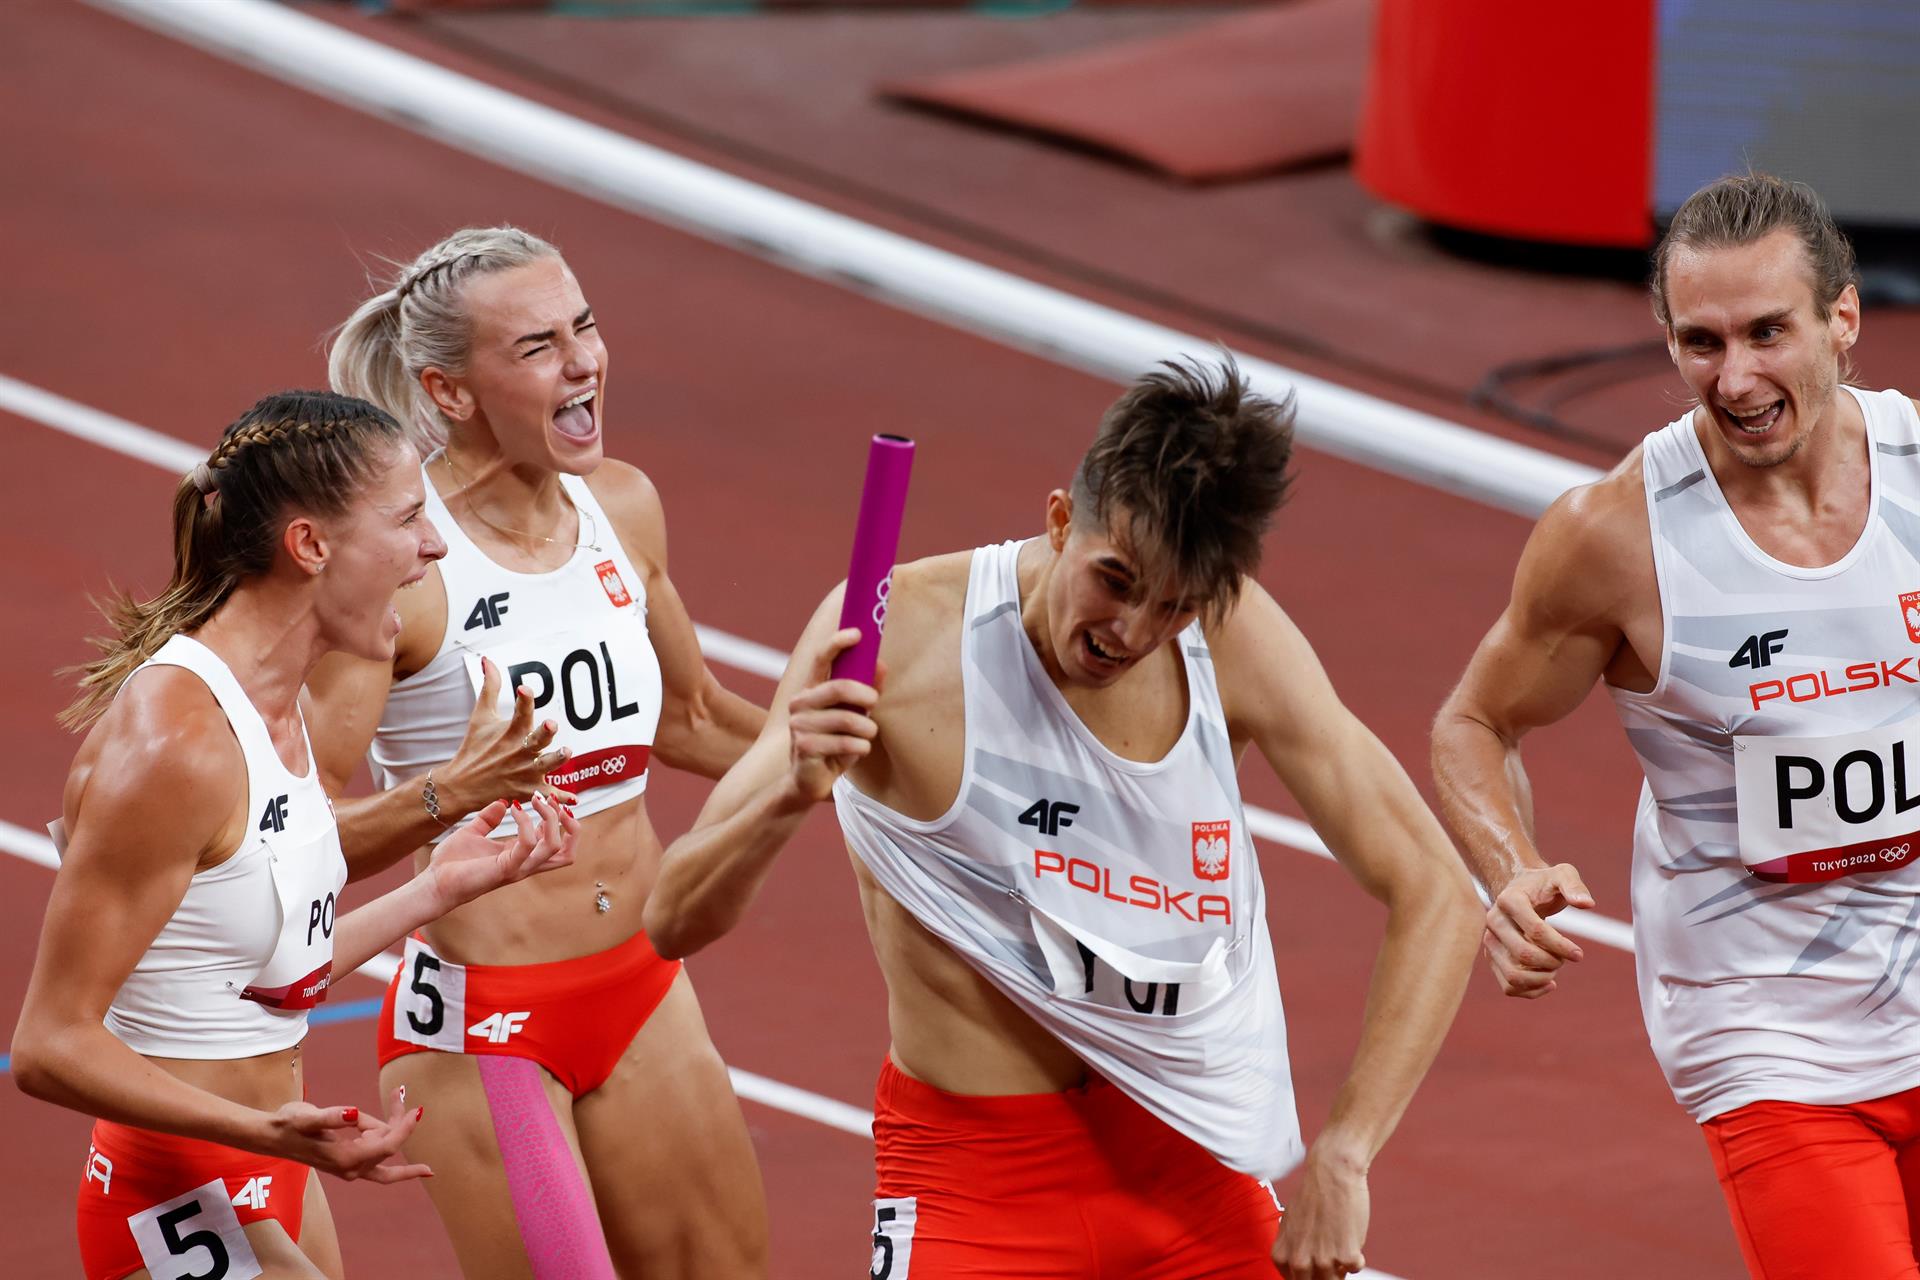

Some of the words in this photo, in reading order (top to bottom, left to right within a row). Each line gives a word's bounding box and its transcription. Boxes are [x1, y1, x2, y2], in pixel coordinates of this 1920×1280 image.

[464, 592, 510, 631] 4F
[1729, 629, 1789, 670] 4F
[508, 641, 640, 732] POL
[1749, 657, 1920, 712] POLSK
[546, 771, 579, 786] TOKYO
[580, 765, 600, 780] 2020
[1775, 740, 1920, 829] POL
[259, 794, 288, 833] 4F
[1018, 798, 1080, 836] 4F
[1194, 823, 1228, 833] POLSKA
[1812, 859, 1848, 872] TOKYO
[1850, 853, 1876, 866] 2020
[1034, 849, 1231, 925] POLSKA
[406, 951, 445, 1036] 5
[467, 1011, 532, 1043] 4F
[231, 1175, 273, 1210] 4F
[156, 1200, 229, 1280] 5
[871, 1207, 896, 1280] 5
